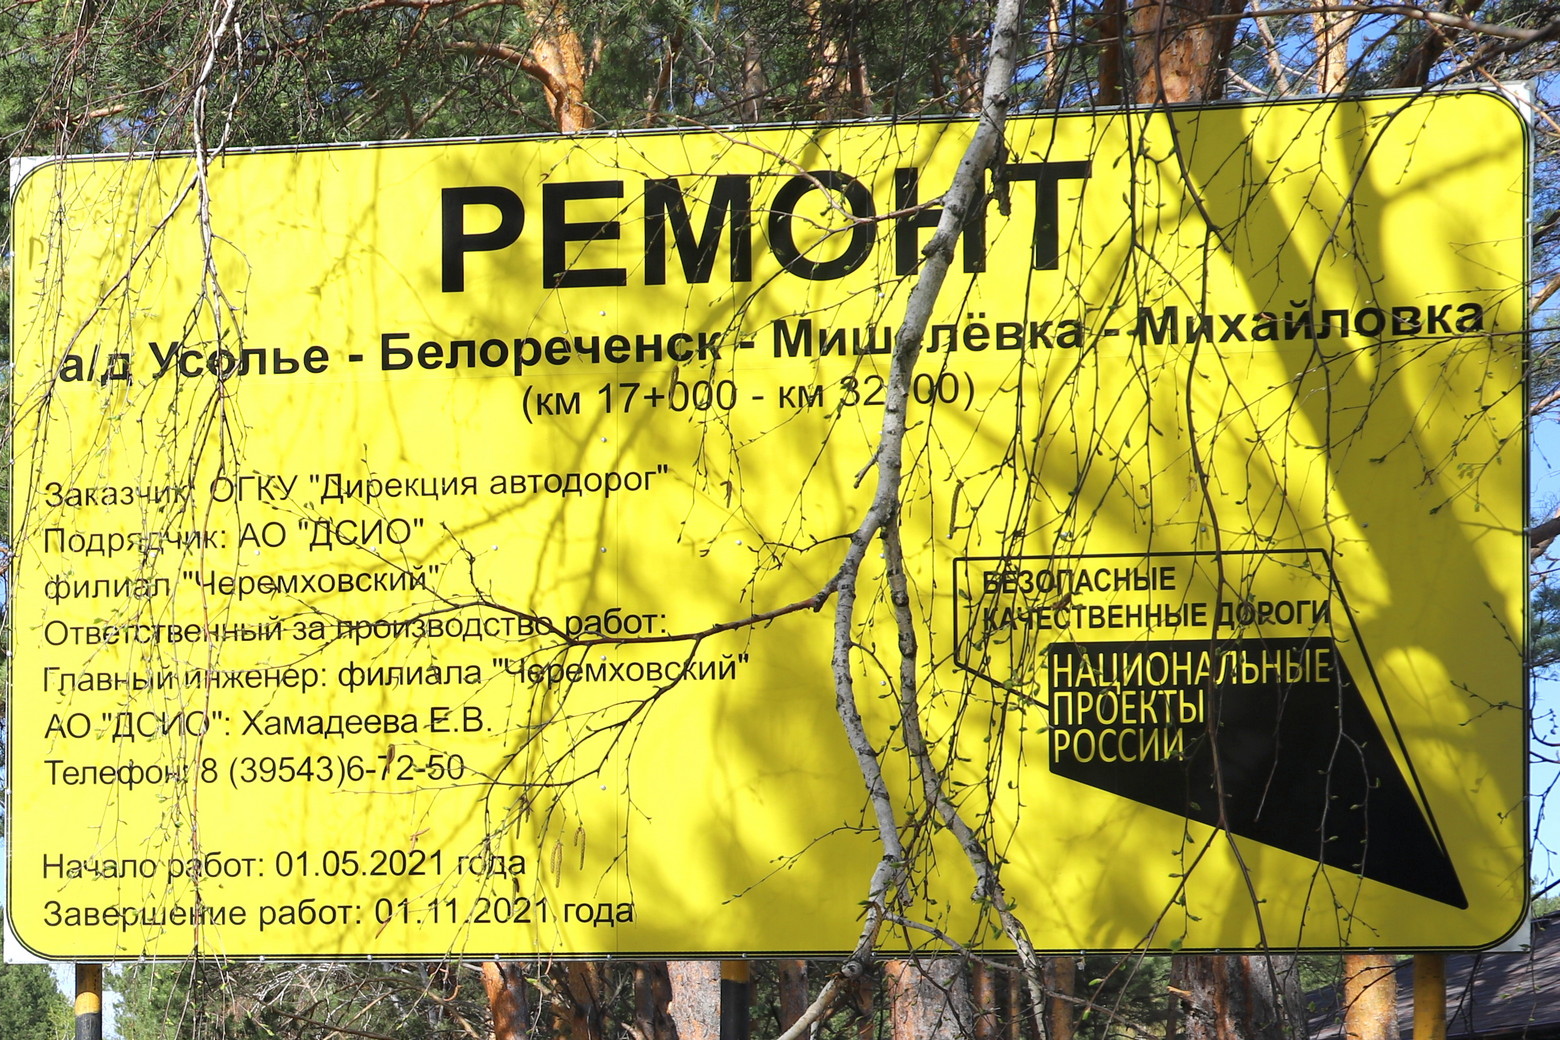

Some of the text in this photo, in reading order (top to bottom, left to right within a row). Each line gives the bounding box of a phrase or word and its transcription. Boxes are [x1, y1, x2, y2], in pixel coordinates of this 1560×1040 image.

[441, 160, 1092, 293] РЕМОНТ
[59, 343, 133, 387] а/д
[148, 341, 329, 380] Усолье
[381, 331, 722, 376] Белореченск
[773, 311, 1083, 358] Мишлёвка
[1138, 300, 1485, 347] Михайловка
[522, 385, 580, 424] (км
[598, 379, 737, 414] 17+000
[779, 385, 824, 409] км
[839, 371, 975, 411] 3200)
[209, 474, 298, 503] ОГКУ
[309, 473, 478, 505] "Дирекция
[490, 464, 669, 498] автодорог"
[44, 518, 424, 558] Подрядчик: АО "ДСИО"
[44, 564, 440, 606] филиал "Черемховский"
[982, 565, 1176, 595] БЕЗОПАСНЫЕ
[44, 607, 667, 646] Ответственный за производство работ:
[983, 599, 1330, 632] КАЧЕСТВЕННЫЕ ДОРОГИ
[43, 653, 749, 696] Главный инженер: филиала "Черемховский"
[1053, 647, 1331, 696] НАЦИОНАЛЬНЫЕ
[44, 705, 492, 743] АО "ДСИО": Хамадеева Е.В.
[1053, 688, 1205, 726] ПРОЕКТЫ
[1054, 727, 1184, 763] РОССИИ
[43, 753, 464, 791] Телефон: 8 (39543)6-72-50
[42, 849, 527, 884] Начало работ: 01.05.2021 года
[43, 896, 634, 933] Завершение работ: 01.11.2021 года
